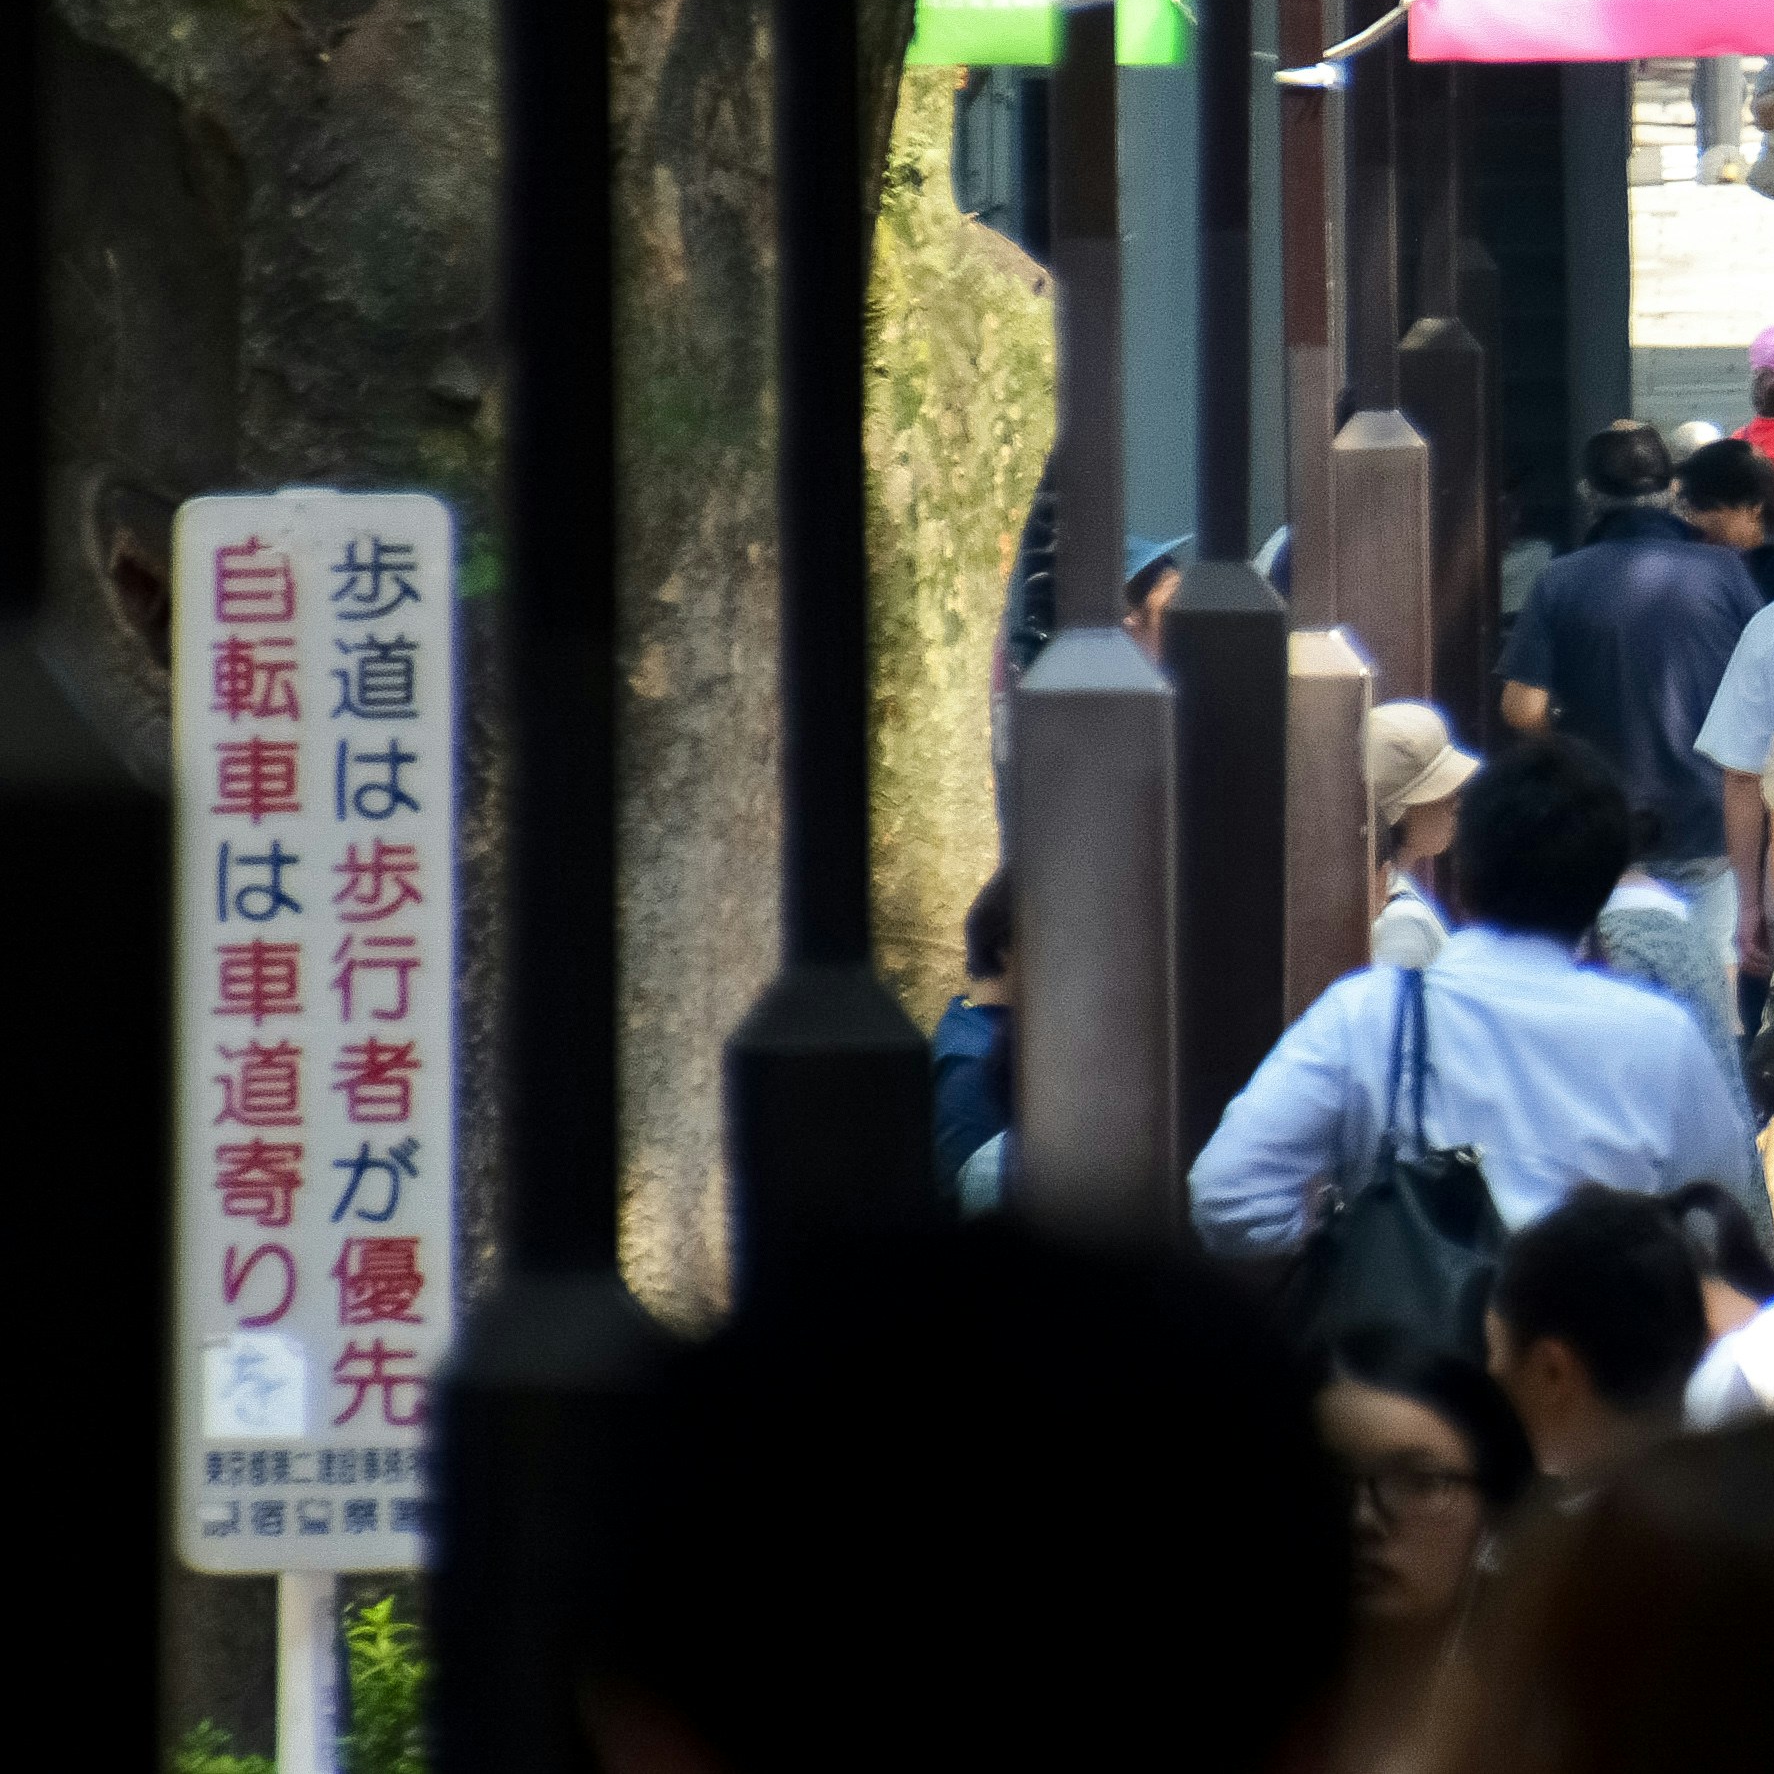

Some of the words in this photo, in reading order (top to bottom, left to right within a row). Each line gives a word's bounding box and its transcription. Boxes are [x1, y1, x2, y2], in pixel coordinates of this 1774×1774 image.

[329, 535, 429, 1427] 歩道は歩行者が優先
